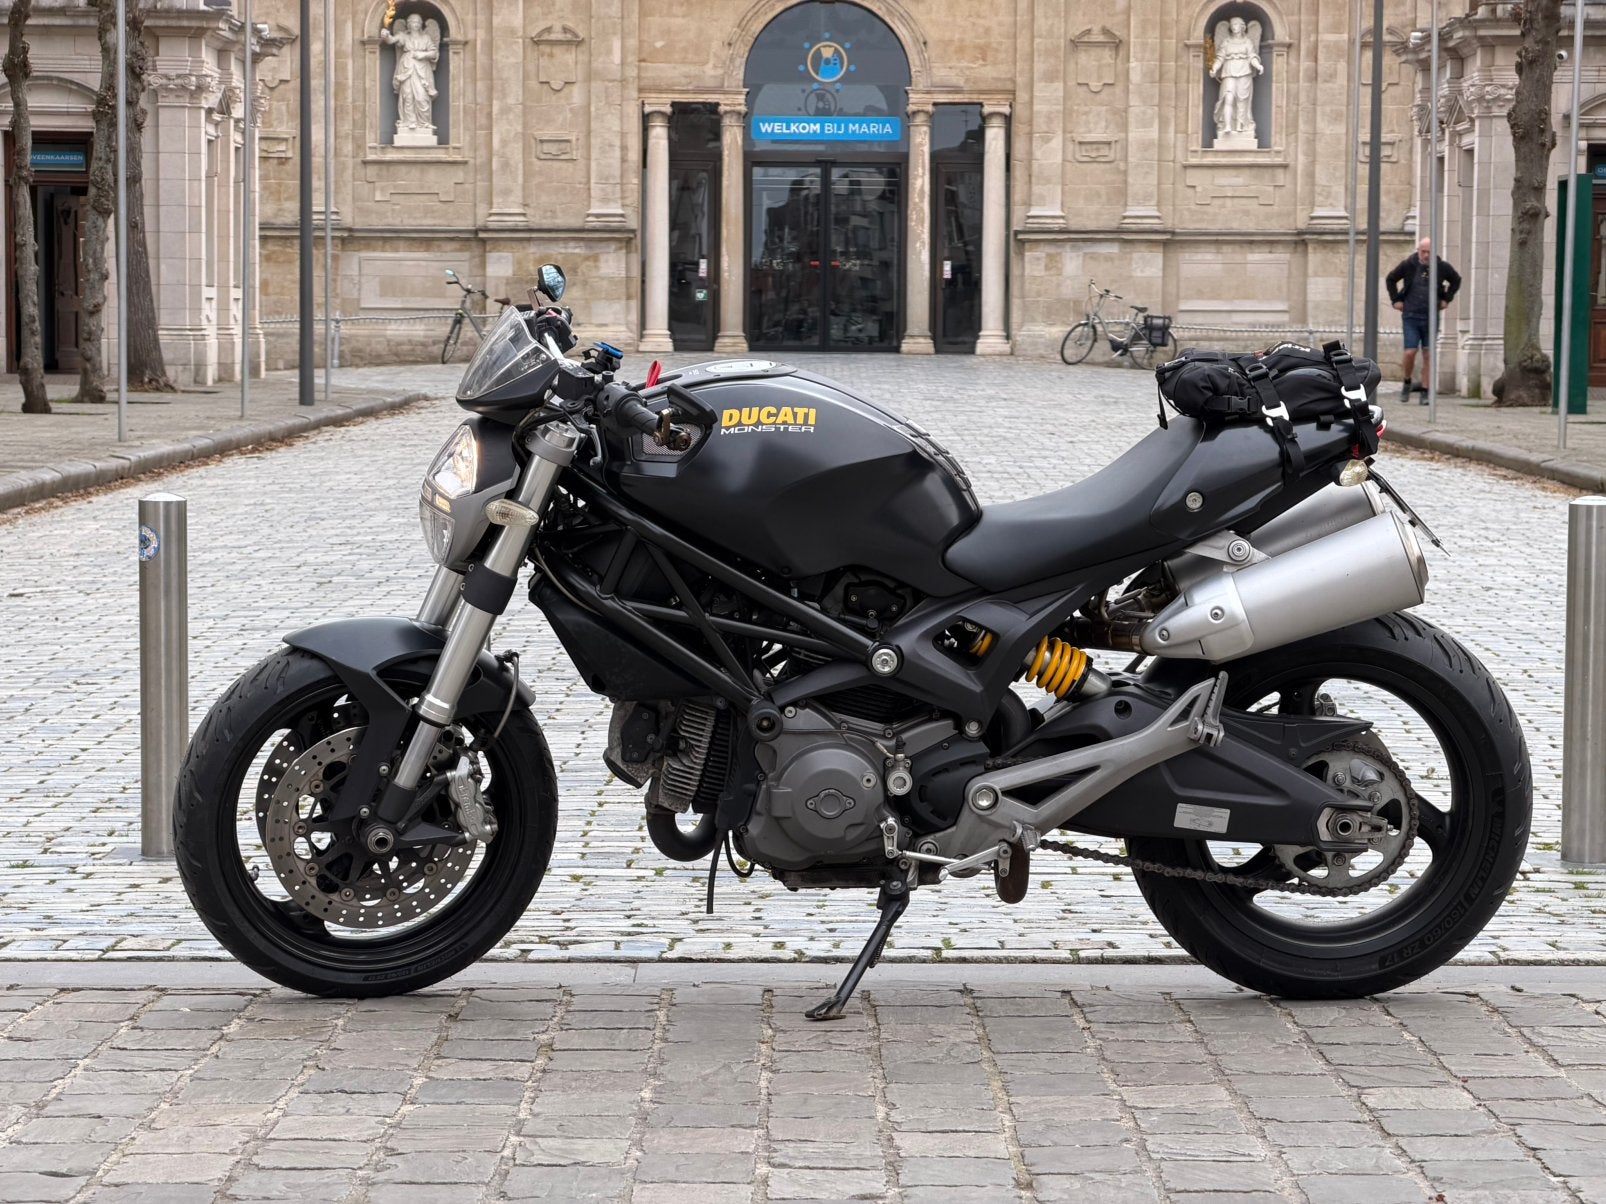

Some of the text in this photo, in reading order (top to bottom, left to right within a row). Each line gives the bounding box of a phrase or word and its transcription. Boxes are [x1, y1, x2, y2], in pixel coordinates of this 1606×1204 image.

[759, 122, 893, 134] WELKOM BIJ MARIA
[721, 406, 817, 427] DUCATI
[720, 424, 815, 435] MONSTER
[1468, 818, 1502, 899] MICHELIN
[1402, 940, 1420, 958] ZR
[1384, 952, 1400, 967] 17
